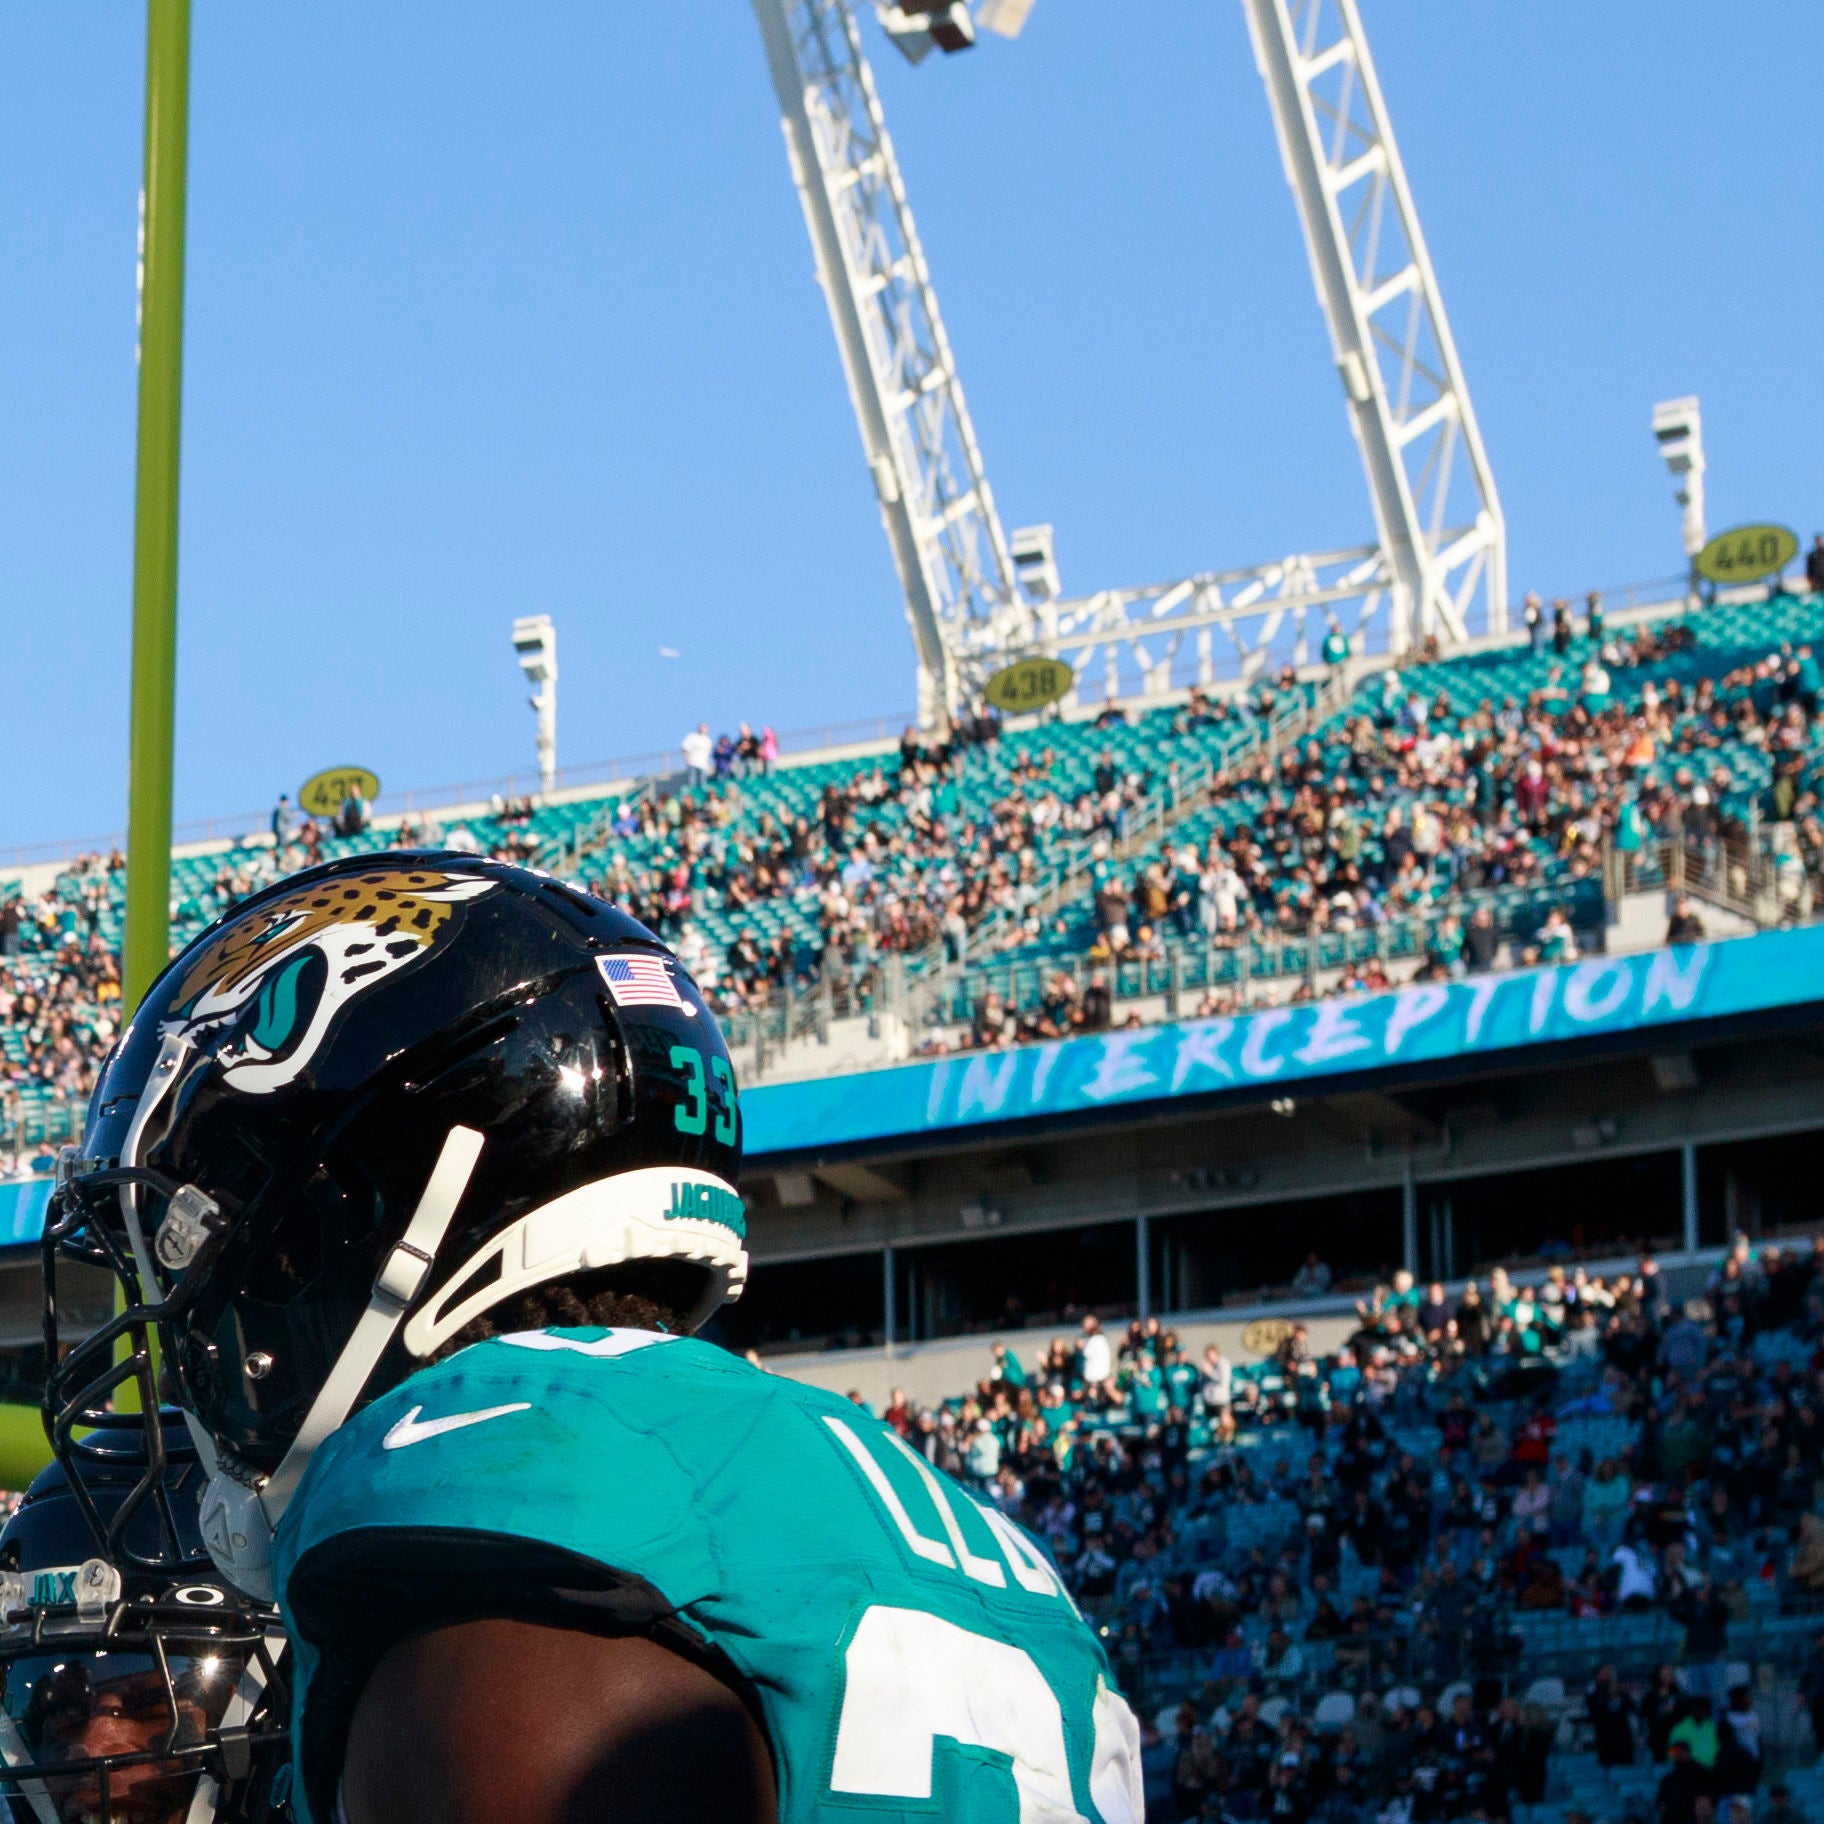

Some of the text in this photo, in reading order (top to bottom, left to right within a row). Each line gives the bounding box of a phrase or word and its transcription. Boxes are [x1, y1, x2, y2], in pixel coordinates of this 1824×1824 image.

[1713, 534, 1778, 570] 440
[999, 668, 1054, 699] 438
[926, 941, 1718, 1123] INTERCEPTION
[669, 1045, 737, 1148] 33
[27, 1571, 76, 1605] JAX
